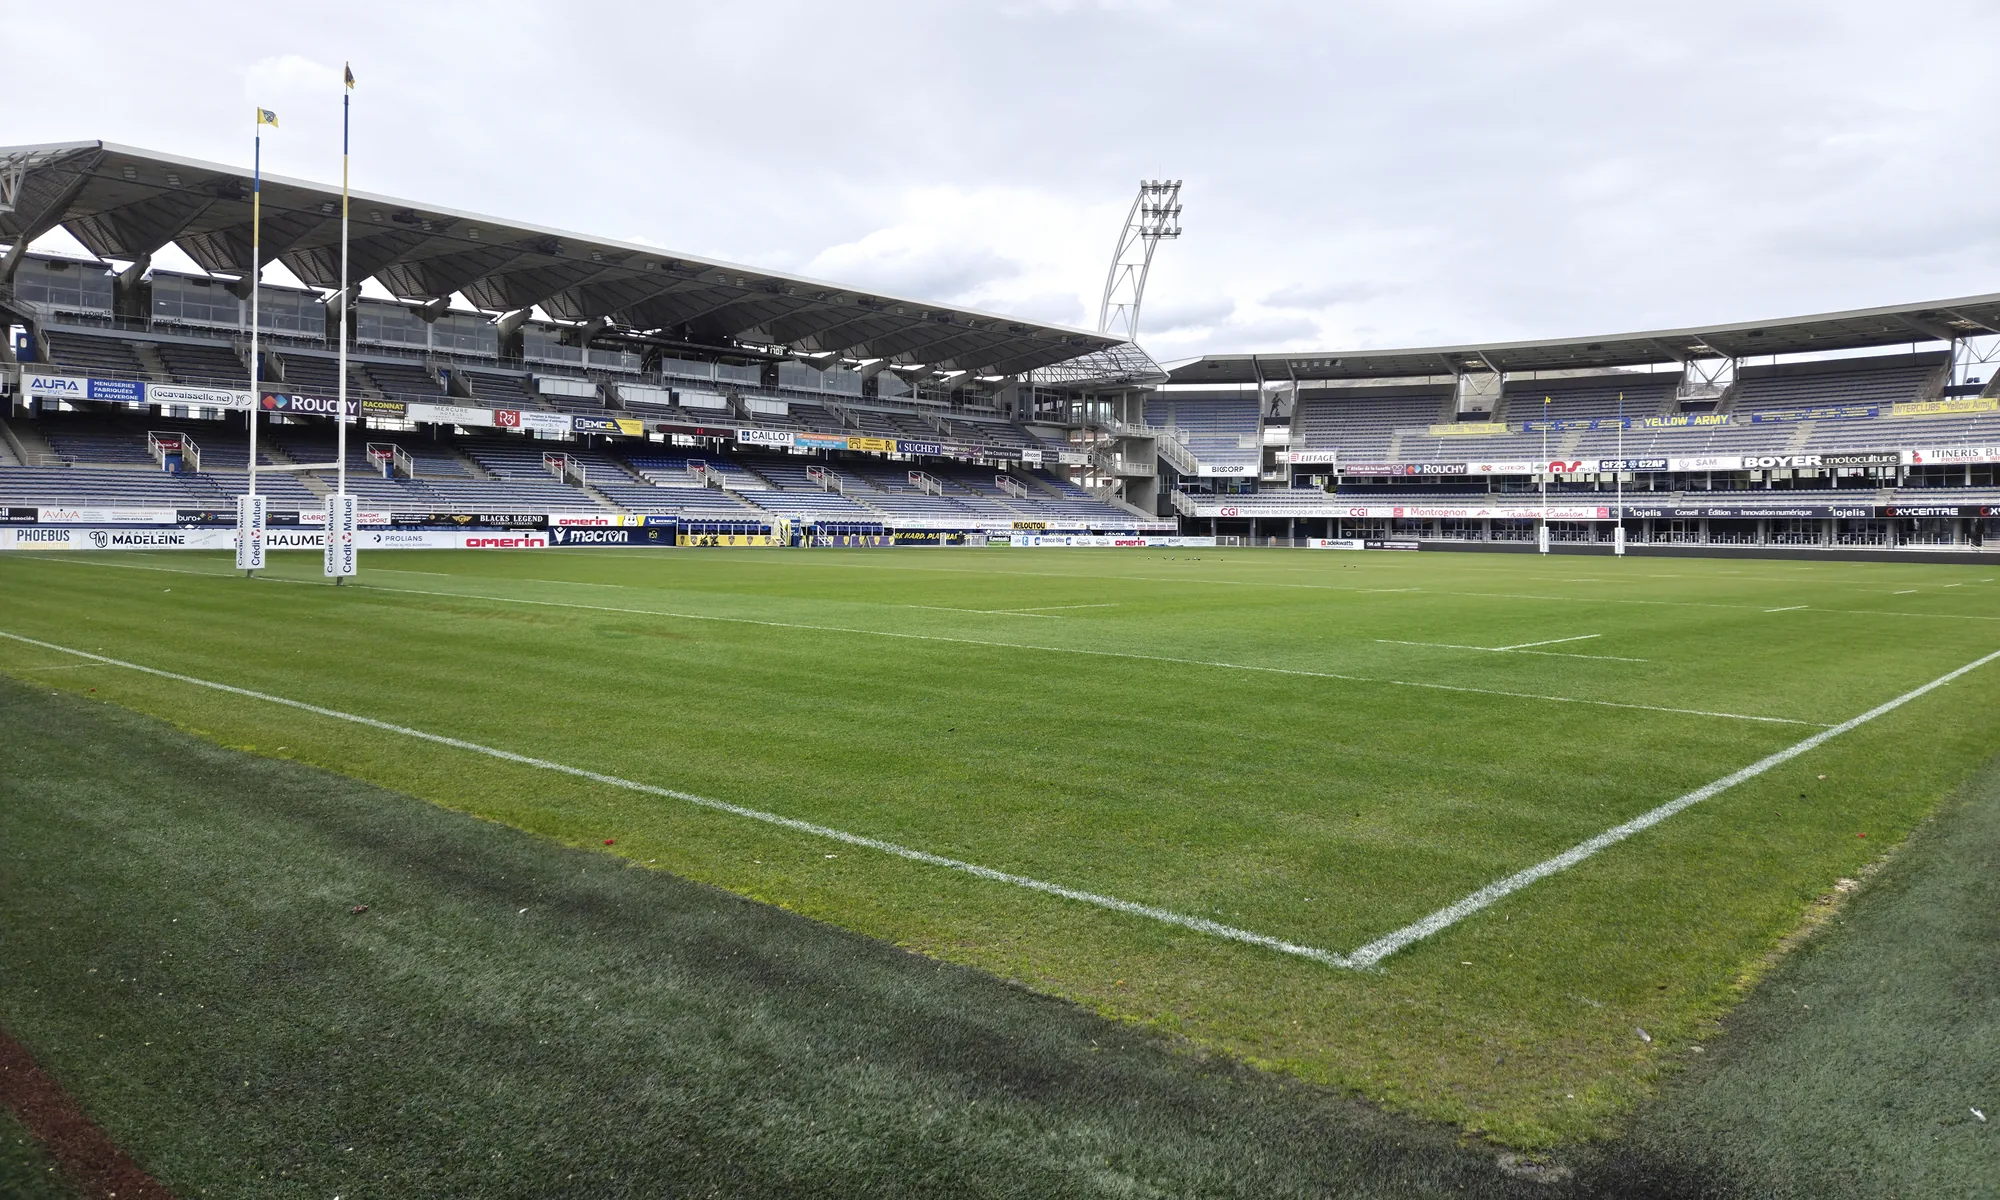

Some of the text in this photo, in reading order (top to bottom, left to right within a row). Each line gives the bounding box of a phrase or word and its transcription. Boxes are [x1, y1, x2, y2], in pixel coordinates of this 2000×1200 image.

[32, 378, 78, 390] AURA
[154, 390, 230, 402] locavaisselle.net
[362, 401, 404, 410] RACONNAT
[1894, 403, 1940, 413] INTERCLUBS
[1644, 415, 1729, 426] YELLOW ARMY
[752, 431, 790, 441] CAILLOT
[904, 443, 939, 456] SUCHET
[1932, 449, 1978, 458] ITINERIS
[1744, 454, 1897, 467] BOYER motoculture
[1423, 464, 1465, 473] ROUCHY
[1220, 508, 1238, 516] CGI
[1350, 508, 1368, 516] CGI
[1410, 508, 1466, 517] Montrognon
[1980, 507, 2000, 516] OX
[559, 516, 608, 525] omerin
[17, 530, 70, 541] PHOEBUS
[251, 499, 261, 565] Crédit Mutuel
[570, 530, 628, 542] macron
[112, 535, 185, 544] MADELEINE
[466, 534, 544, 547] omerin
[1115, 537, 1145, 546] omerin
[343, 544, 352, 573] Crédit
